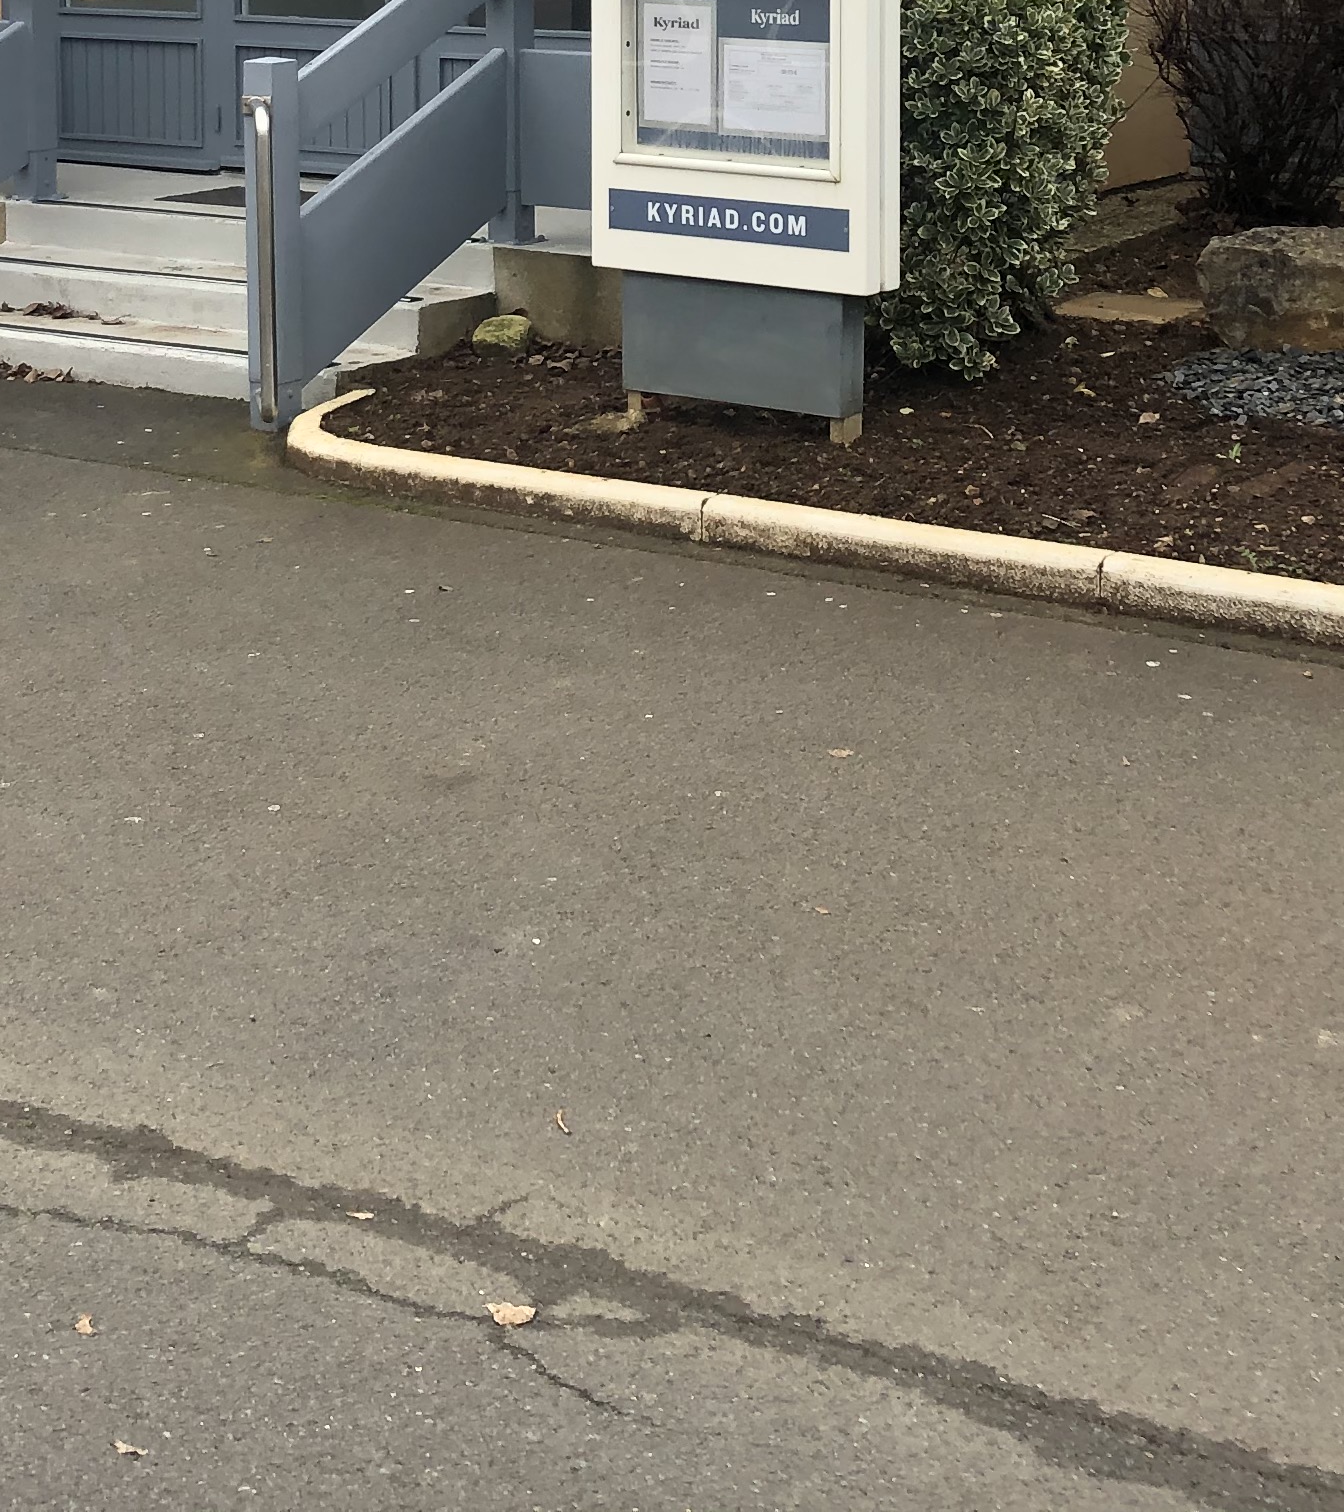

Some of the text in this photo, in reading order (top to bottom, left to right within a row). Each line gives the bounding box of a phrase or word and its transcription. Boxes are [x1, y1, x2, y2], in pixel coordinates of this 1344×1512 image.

[653, 16, 700, 31] Kyriad
[750, 8, 800, 29] Kyriad
[646, 201, 808, 237] KYRIAD.COM
